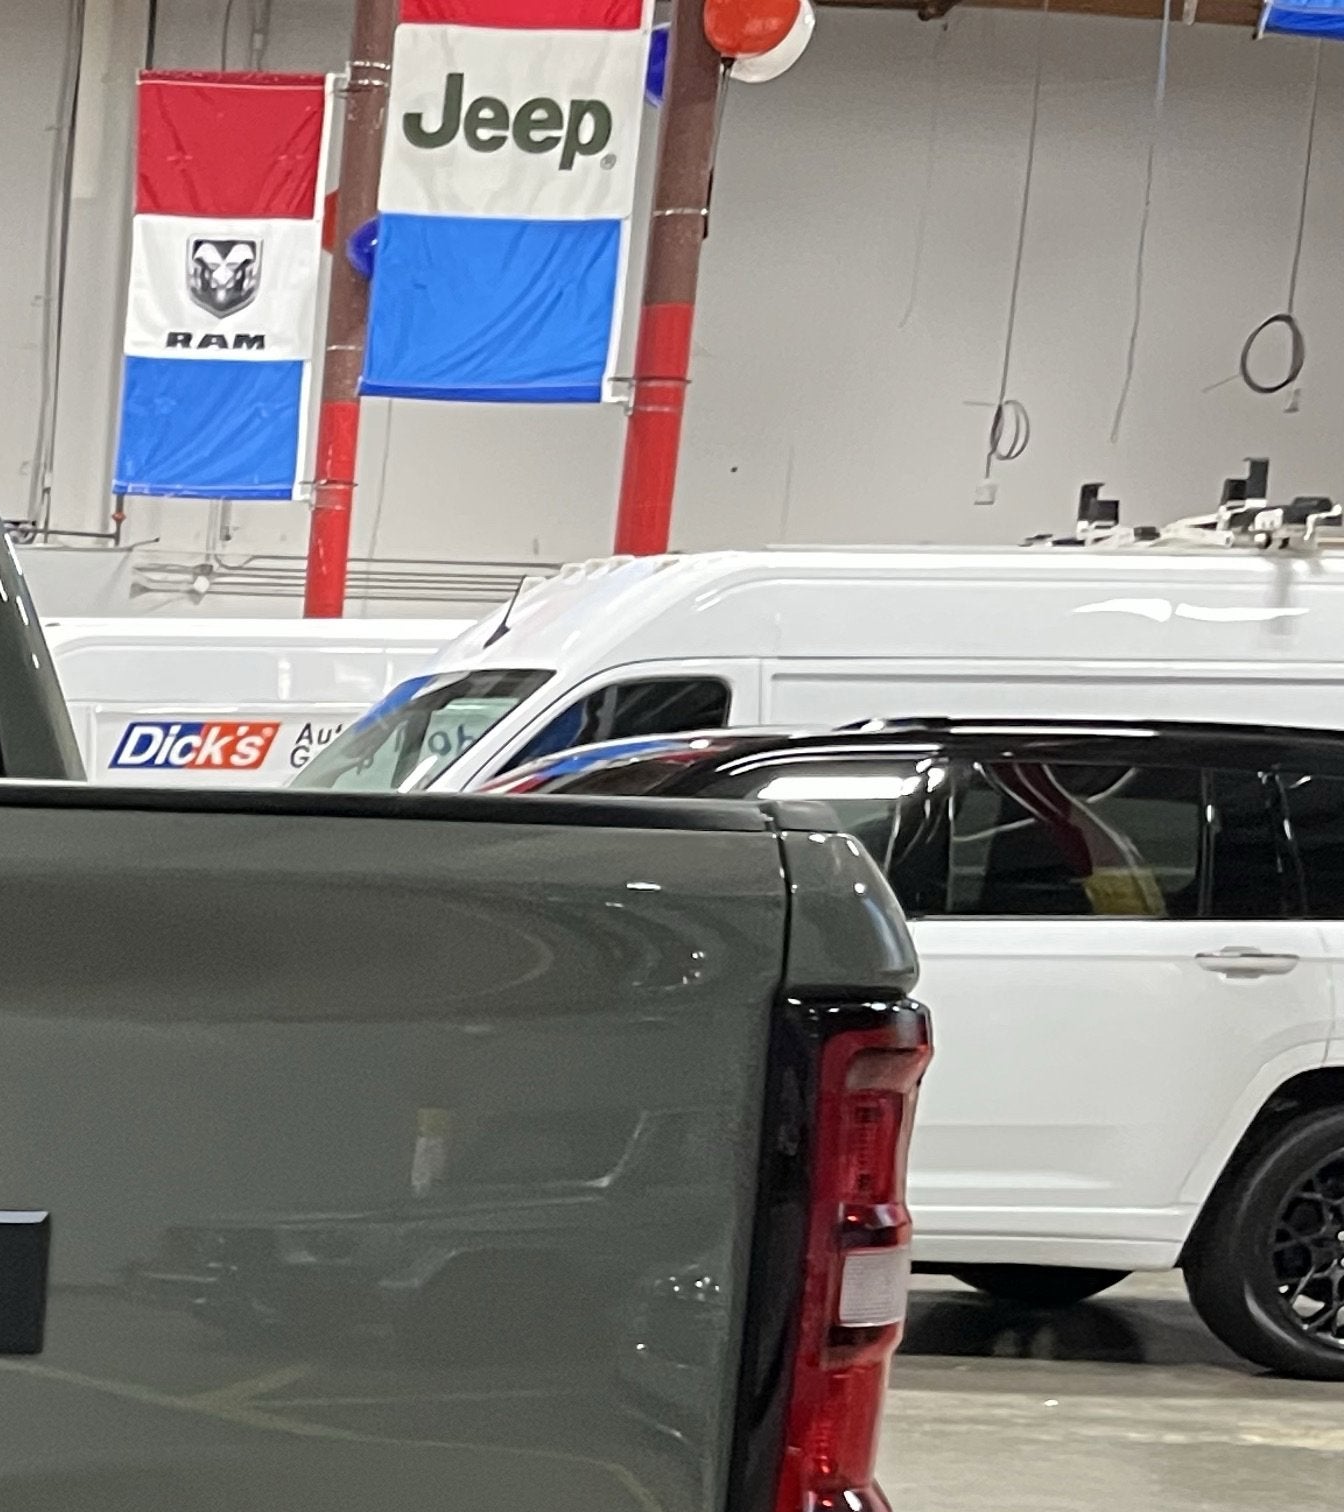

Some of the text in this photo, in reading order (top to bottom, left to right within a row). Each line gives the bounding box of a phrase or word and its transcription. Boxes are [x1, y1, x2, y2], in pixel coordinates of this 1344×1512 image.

[402, 72, 612, 170] Jeep
[165, 331, 266, 350] RAM
[295, 723, 343, 745] Au
